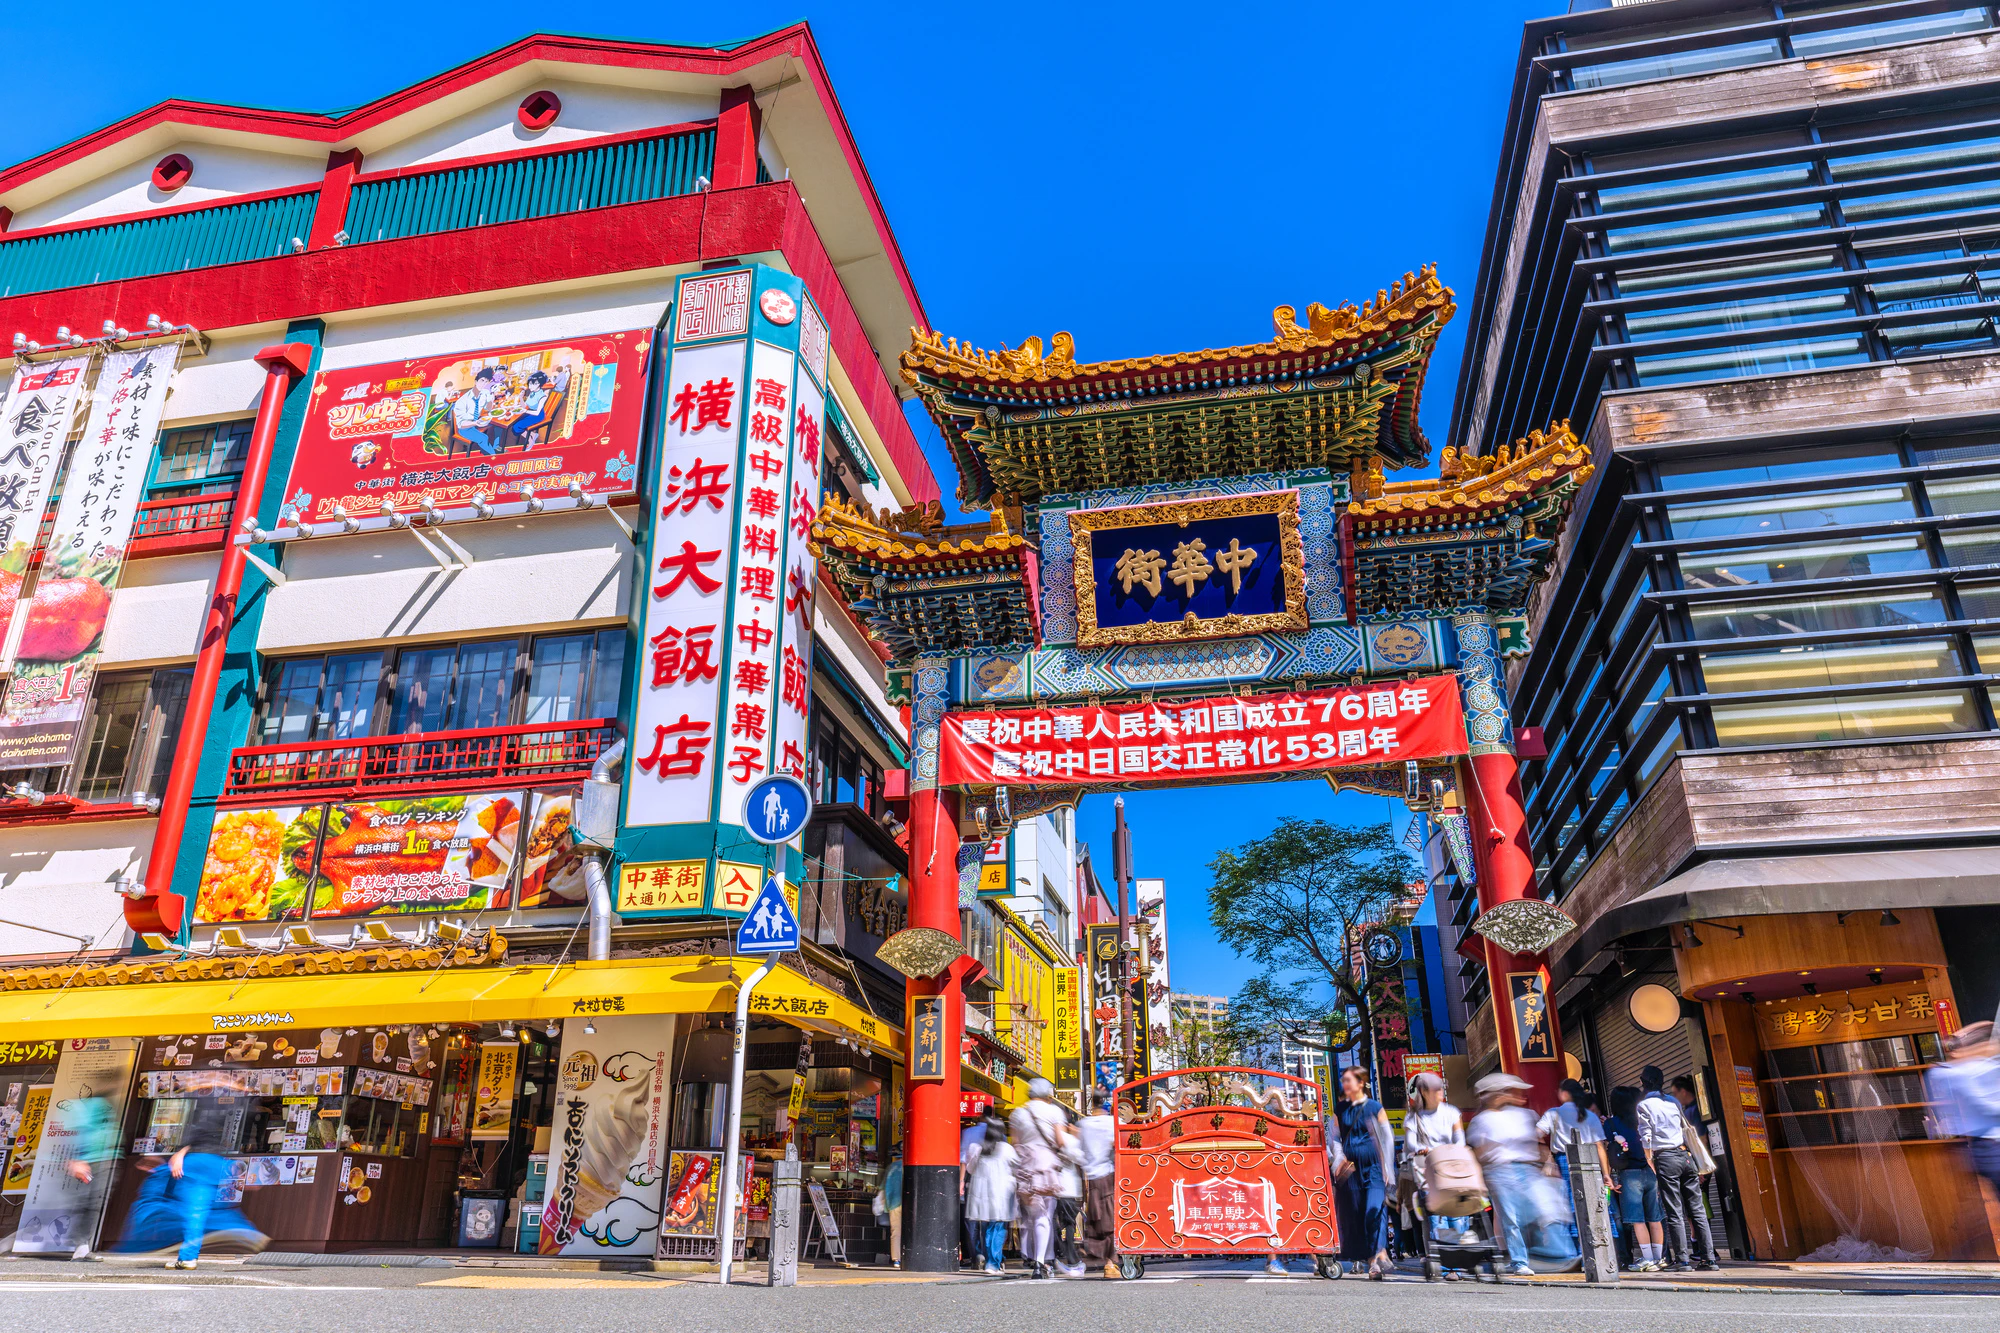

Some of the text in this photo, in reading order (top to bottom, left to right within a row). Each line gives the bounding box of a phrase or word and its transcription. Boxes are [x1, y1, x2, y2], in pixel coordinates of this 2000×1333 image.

[329, 395, 422, 426] ツレ中華
[24, 395, 67, 514] All You Can Eat
[89, 363, 157, 558] 素材と味にこだわった
[355, 477, 395, 491] 中華街
[636, 376, 735, 780] 横浜大飯店
[728, 378, 788, 783] 高級中華料理・中華菓子
[12, 687, 55, 703] ランキング
[15, 674, 59, 691] 食べログ
[961, 688, 1431, 745] 慶祝中華人民共和国成立76周年
[0, 733, 73, 746] www.yokohama-
[1, 746, 66, 758] daihanten.com
[991, 726, 1400, 778] 慶祝中日国交正常化53周年
[369, 809, 468, 828] 食べログ ランキング
[355, 830, 470, 855] 横浜中華街 1位 食べ放題
[351, 871, 461, 890] 素材と味にこだわった
[627, 865, 701, 890] 中華街
[723, 867, 754, 907] 入口
[342, 884, 471, 904] ワンランク上の食べ放題
[624, 890, 699, 907] 大通り入口
[573, 996, 625, 1014] 大粒甘栗
[1056, 972, 1067, 1053] 世界一の肉まん
[1067, 969, 1079, 1057] 中国料理世界チャンピオン
[505, 1052, 514, 1079] 食べ歩き
[563, 1075, 578, 1083] Since
[564, 1055, 597, 1082] 元祖
[490, 1052, 505, 1107] 北京ダック
[23, 1095, 45, 1157] 北京ダック
[647, 1050, 665, 1176] 中華街名物 横浜大飯店の自信作
[555, 1097, 589, 1245] 杏仁ソフトクリーム
[676, 1160, 705, 1210] 新栗入荷
[1201, 1190, 1247, 1204] 不准
[1186, 1206, 1265, 1221] 車馬駛入
[1190, 1222, 1261, 1232] 加賀町警察署
